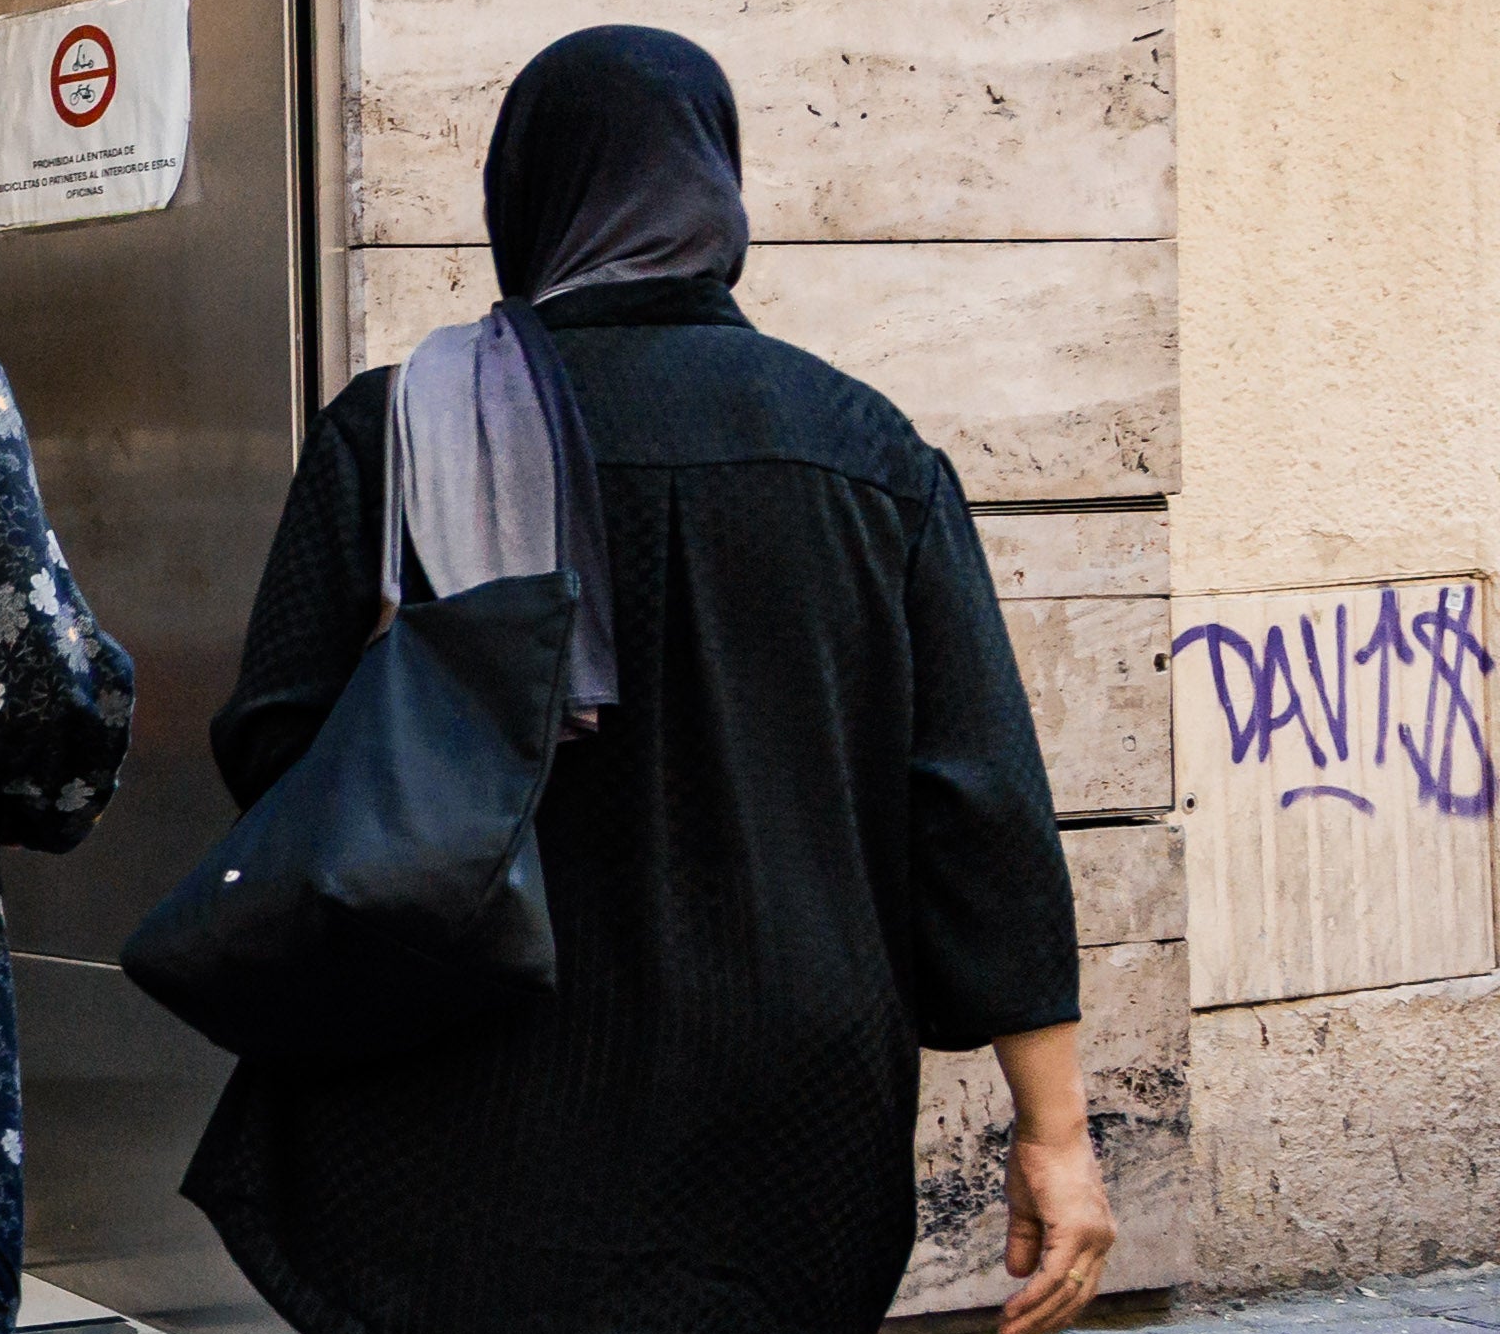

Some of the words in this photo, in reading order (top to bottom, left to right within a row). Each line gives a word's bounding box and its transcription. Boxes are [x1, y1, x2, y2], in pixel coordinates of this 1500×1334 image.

[33, 154, 74, 169] PROHIBIDA
[76, 153, 86, 164] LA
[86, 149, 123, 163] ENTRADA
[124, 145, 135, 156] DE
[50, 171, 88, 186] PATINETES
[89, 169, 99, 179] AL
[102, 164, 137, 178] INTERIOR
[138, 162, 149, 173] DE
[152, 158, 175, 171] ESTAS
[66, 186, 104, 199] OFICINAS
